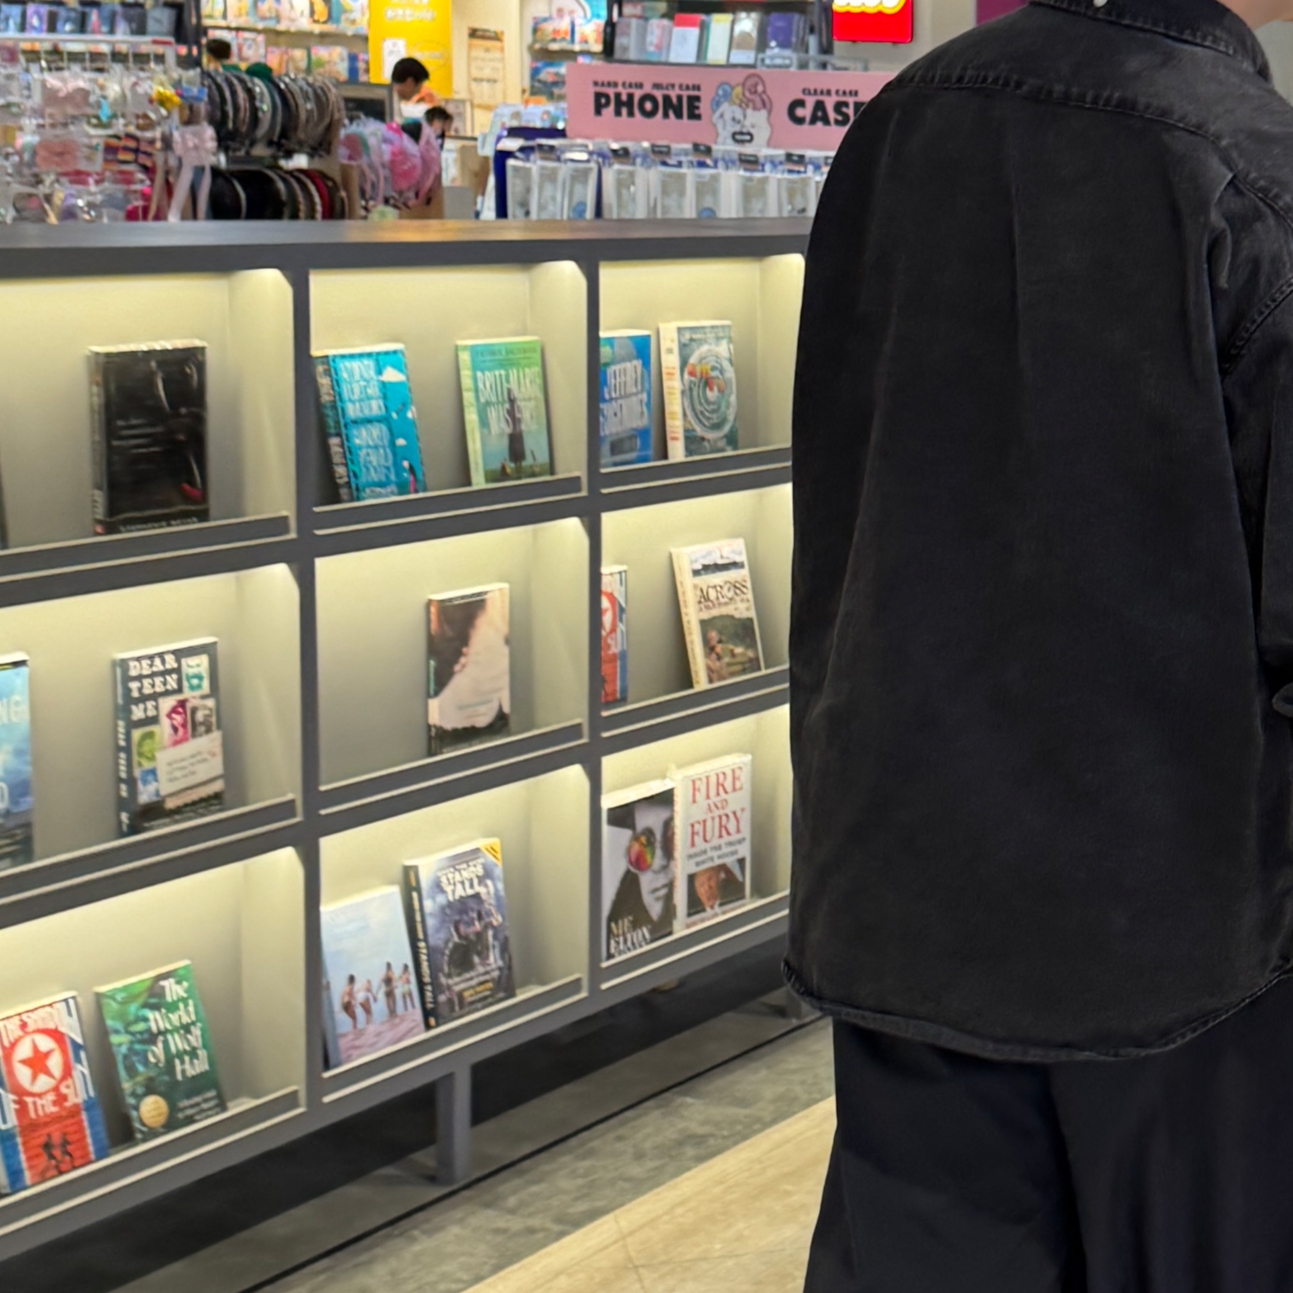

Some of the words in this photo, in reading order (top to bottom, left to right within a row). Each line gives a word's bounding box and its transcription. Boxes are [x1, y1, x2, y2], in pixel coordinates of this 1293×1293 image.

[594, 91, 702, 121] PHONE
[802, 88, 832, 97] CLEAR
[835, 89, 858, 98] CASE
[698, 578, 749, 605] ACROSS
[127, 652, 179, 677] DEAR
[127, 673, 179, 698] TEEN
[131, 699, 158, 722] ME
[690, 765, 744, 804] FIRE
[706, 798, 729, 816] AND
[689, 807, 746, 849] FURY
[157, 977, 189, 1004] The
[174, 1048, 210, 1082] Hall
[22, 1092, 60, 1120] THE
